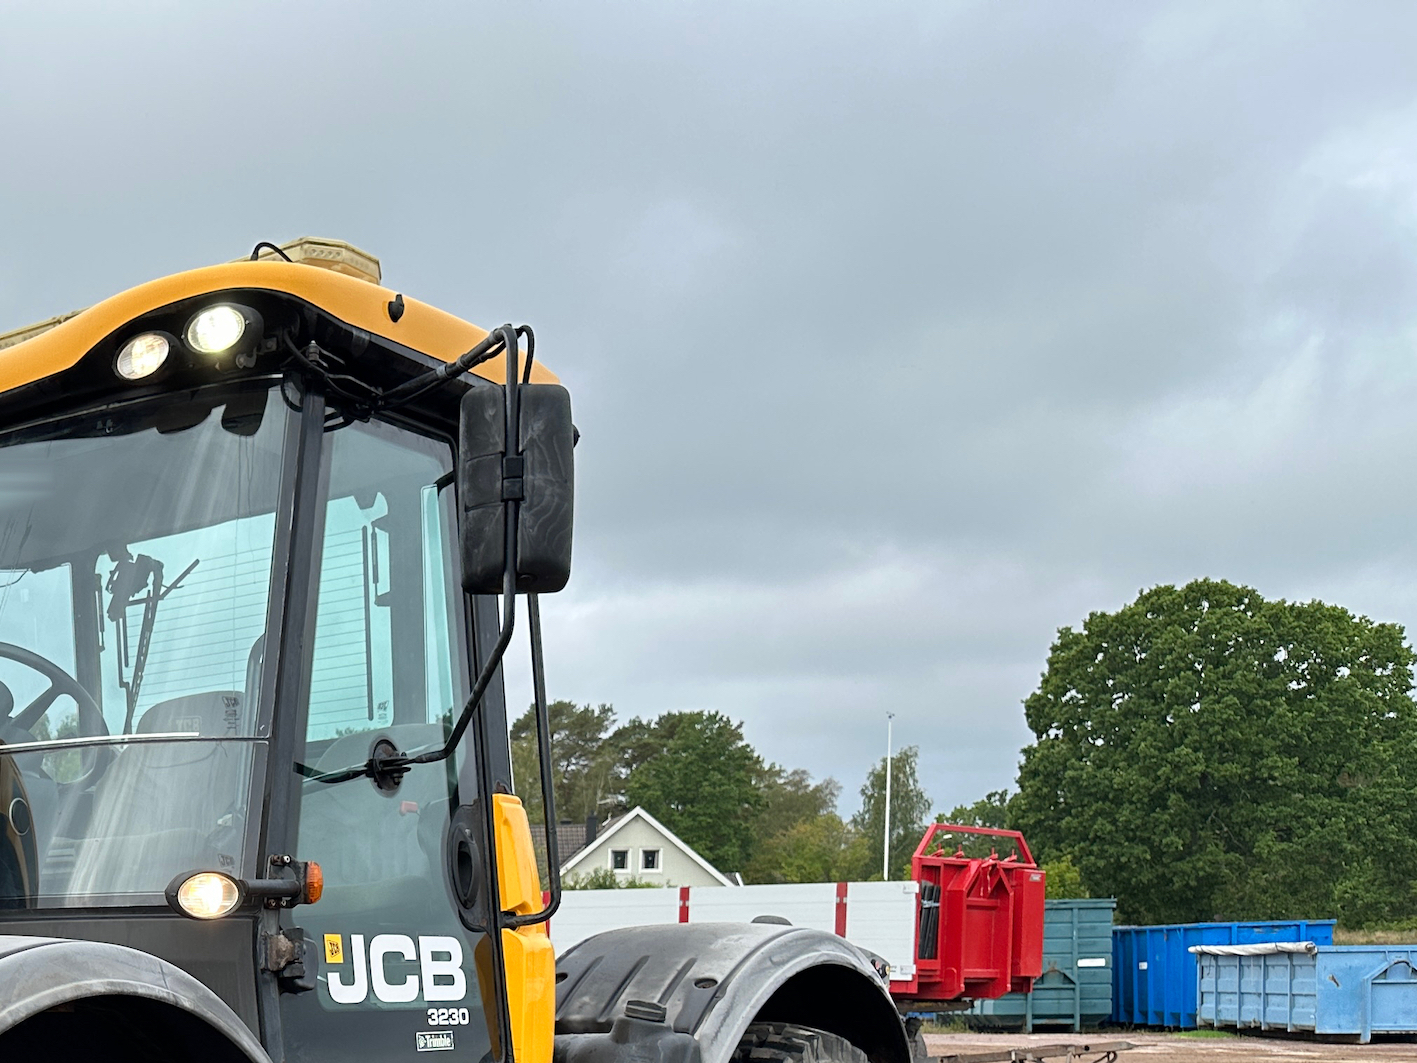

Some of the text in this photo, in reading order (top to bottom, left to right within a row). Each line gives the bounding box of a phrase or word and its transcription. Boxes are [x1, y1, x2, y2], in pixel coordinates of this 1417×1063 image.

[328, 933, 467, 1004] JCB
[427, 1008, 469, 1026] 3230
[425, 1034, 451, 1048] Trimble
